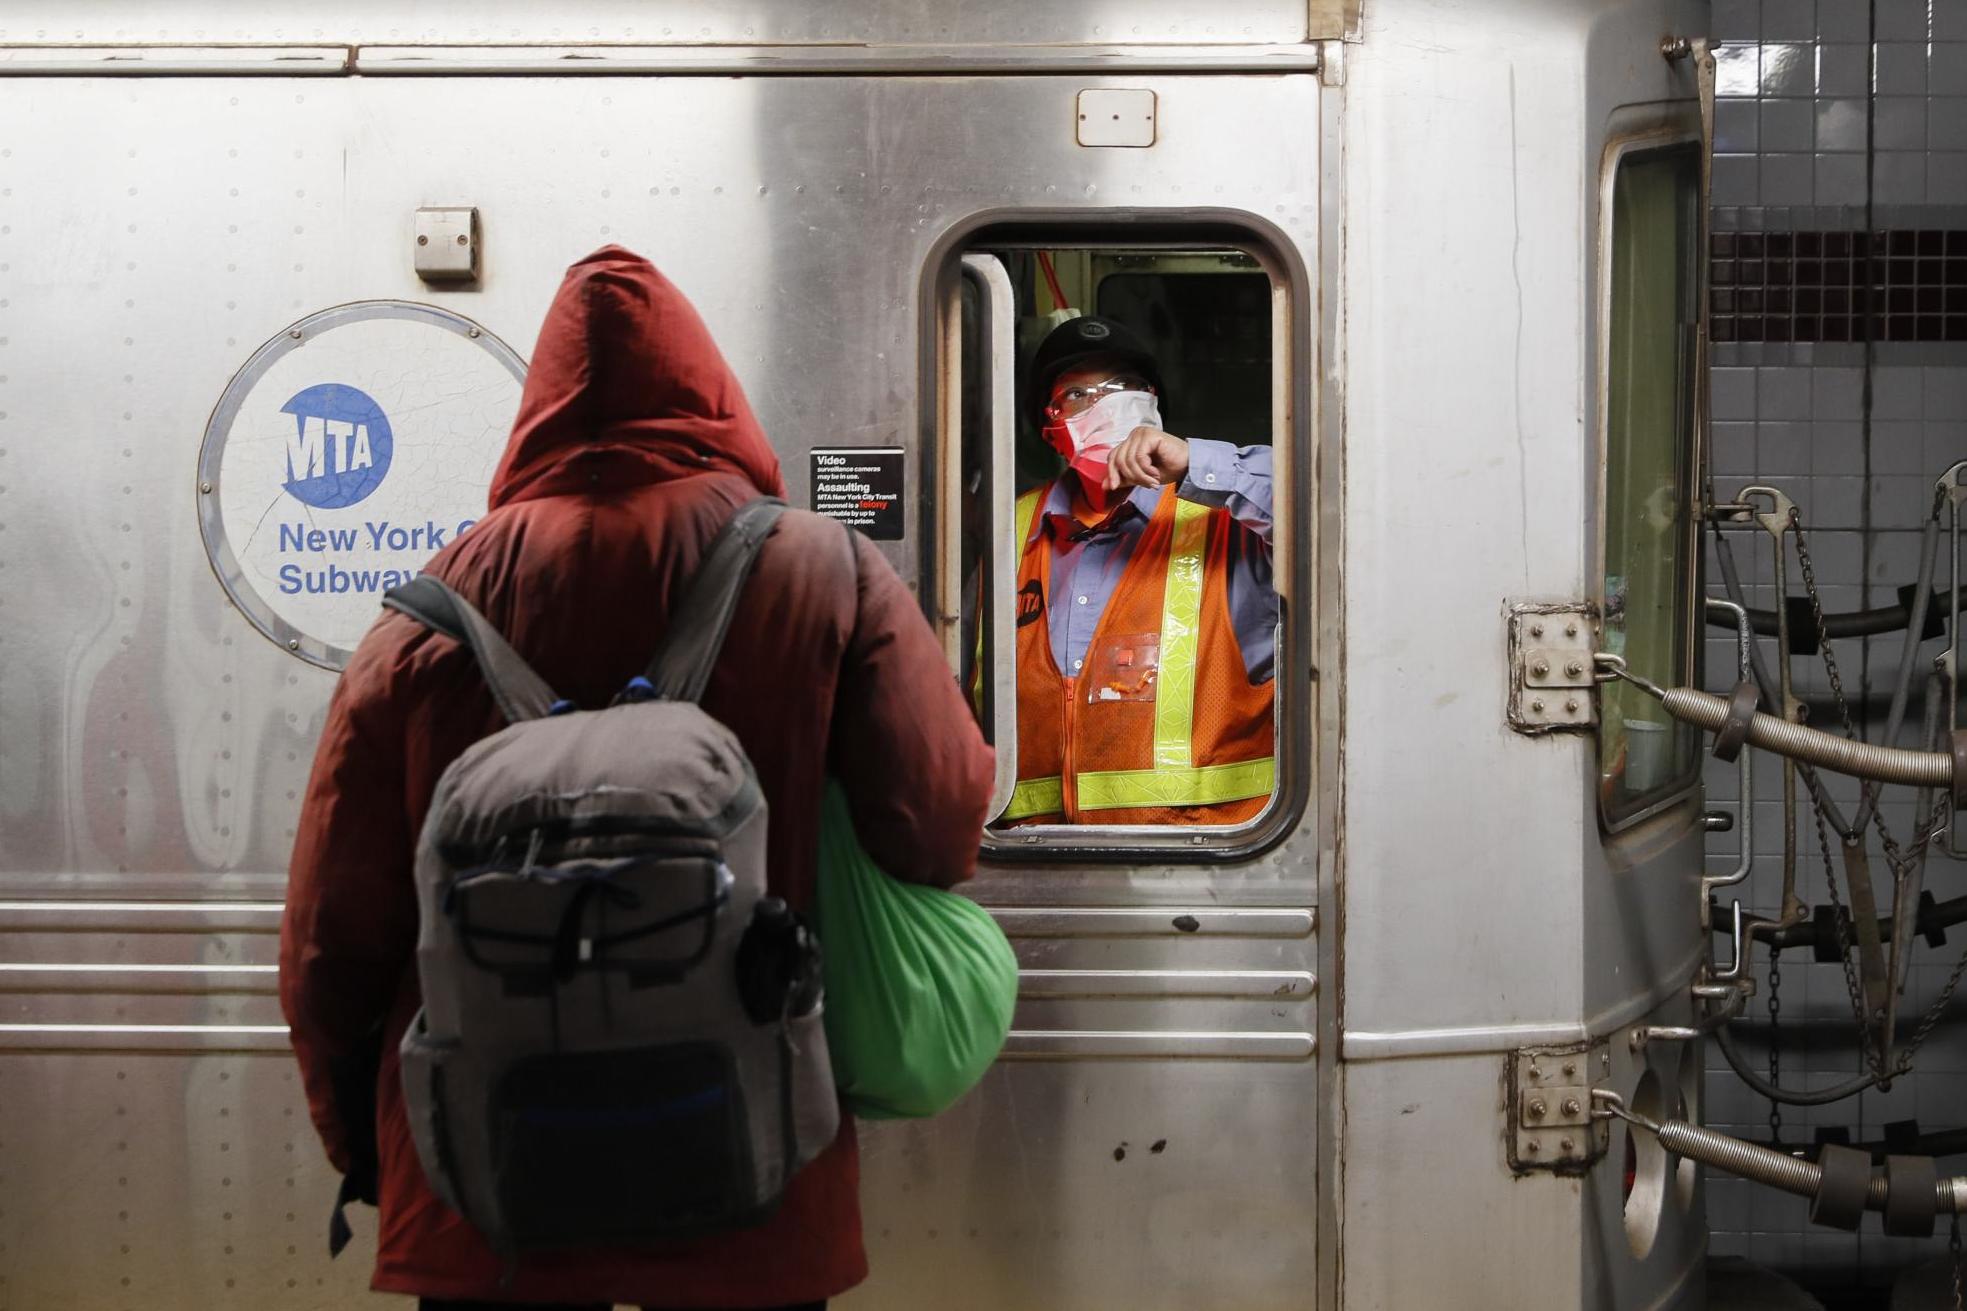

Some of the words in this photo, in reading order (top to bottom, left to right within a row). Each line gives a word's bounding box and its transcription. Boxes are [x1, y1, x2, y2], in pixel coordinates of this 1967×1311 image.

[281, 413, 373, 482] MTA
[817, 456, 846, 465] Video
[817, 482, 870, 493] Assaulting
[860, 501, 888, 510] felony
[279, 523, 357, 552] New
[365, 521, 446, 551] York
